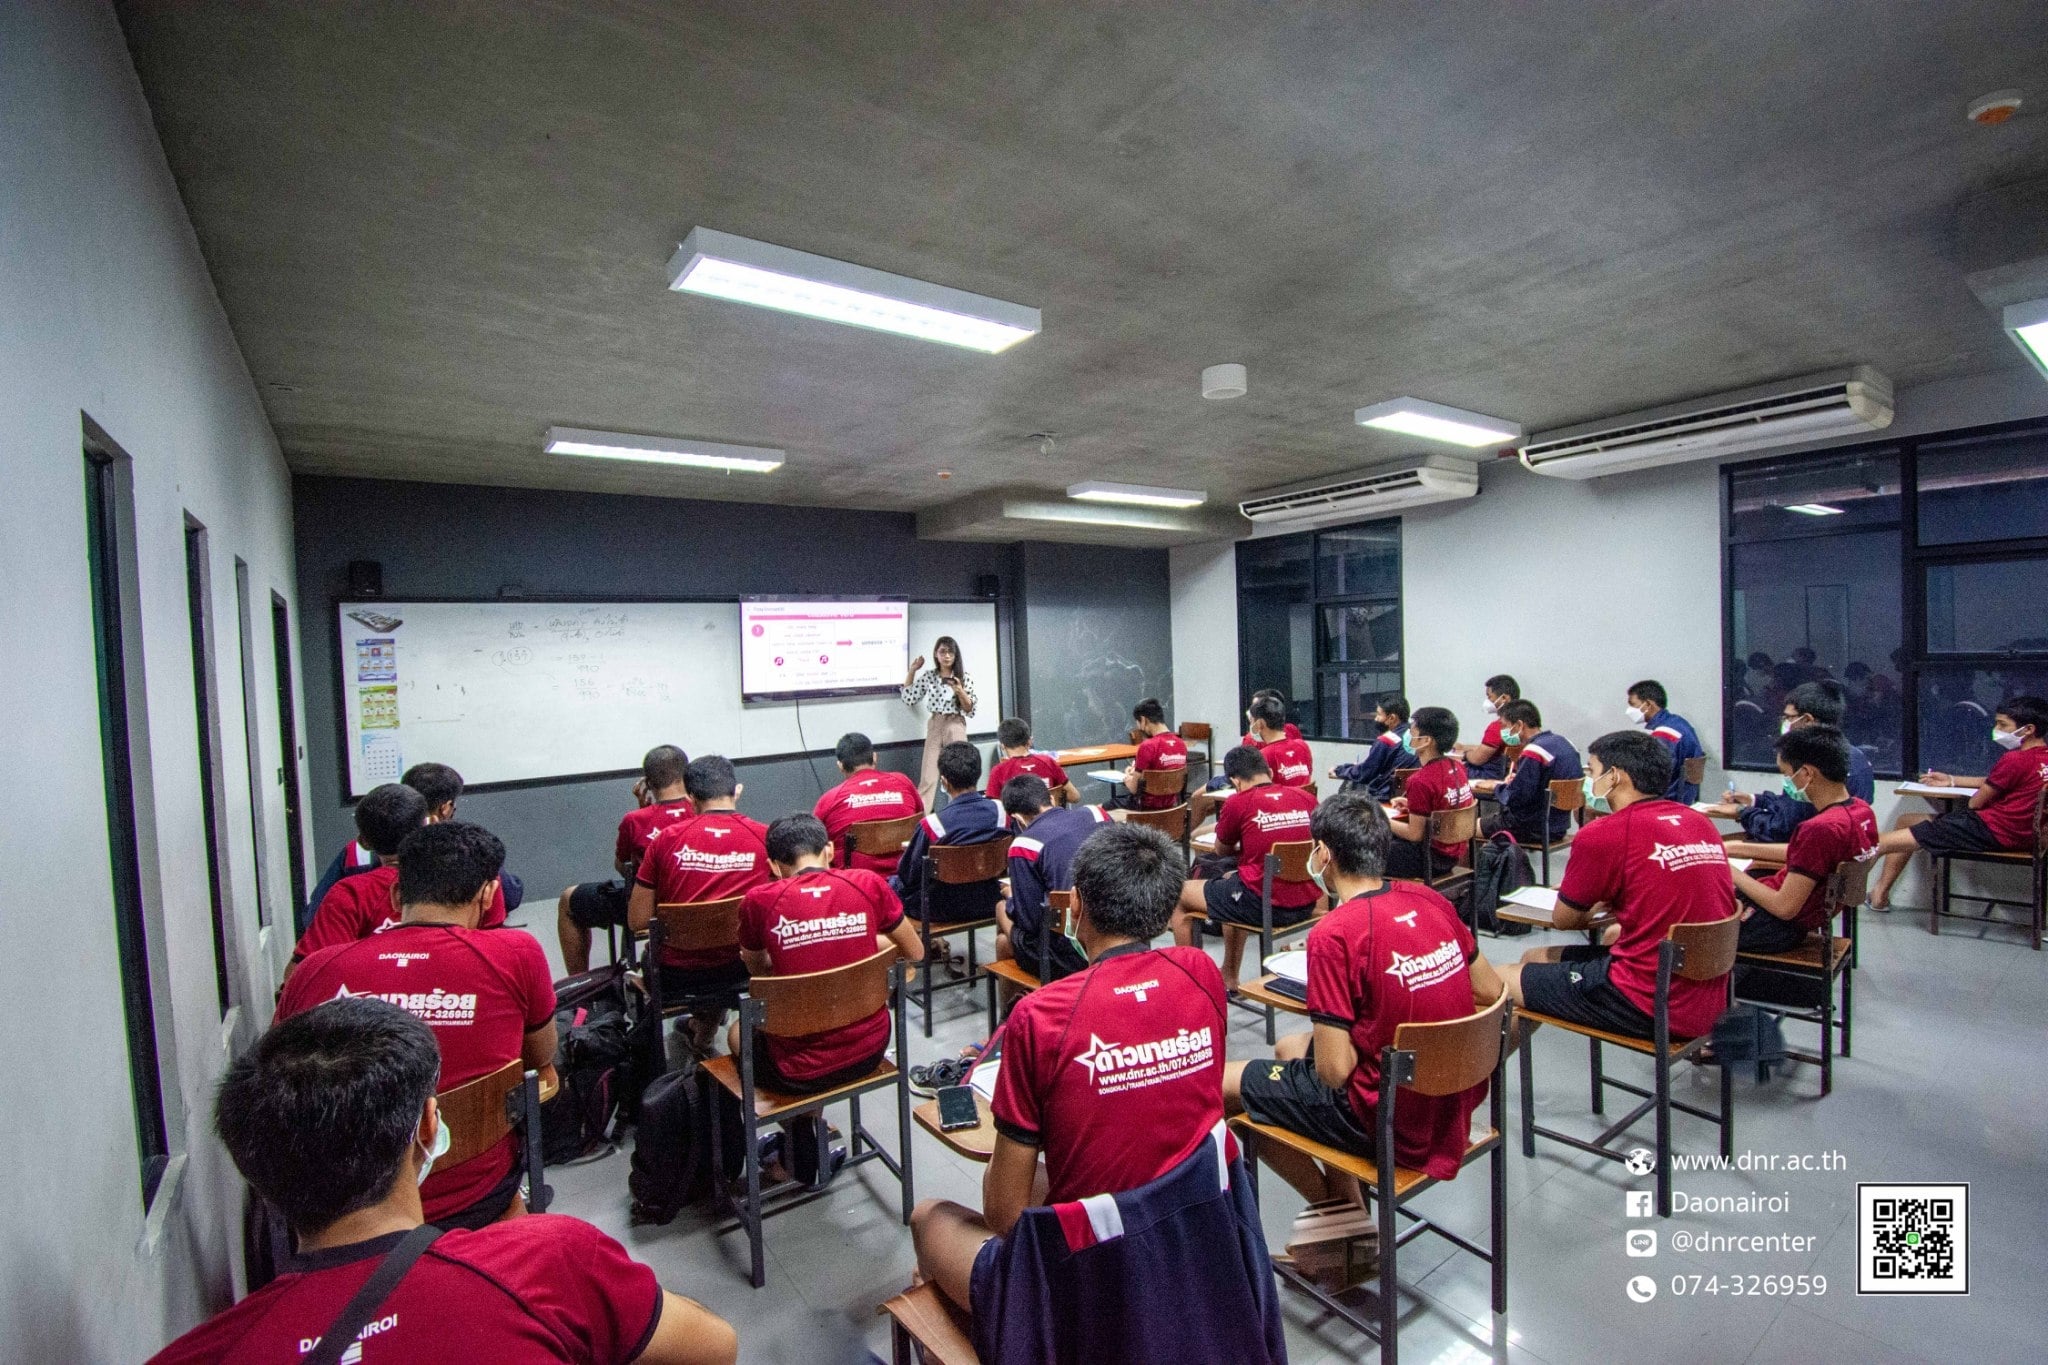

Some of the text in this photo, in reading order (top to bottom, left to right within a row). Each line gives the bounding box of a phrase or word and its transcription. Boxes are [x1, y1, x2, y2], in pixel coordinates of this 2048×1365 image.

[781, 912, 867, 937] ดาวนายร้อย
[1095, 1026, 1212, 1073] ดาวนายร้อย
